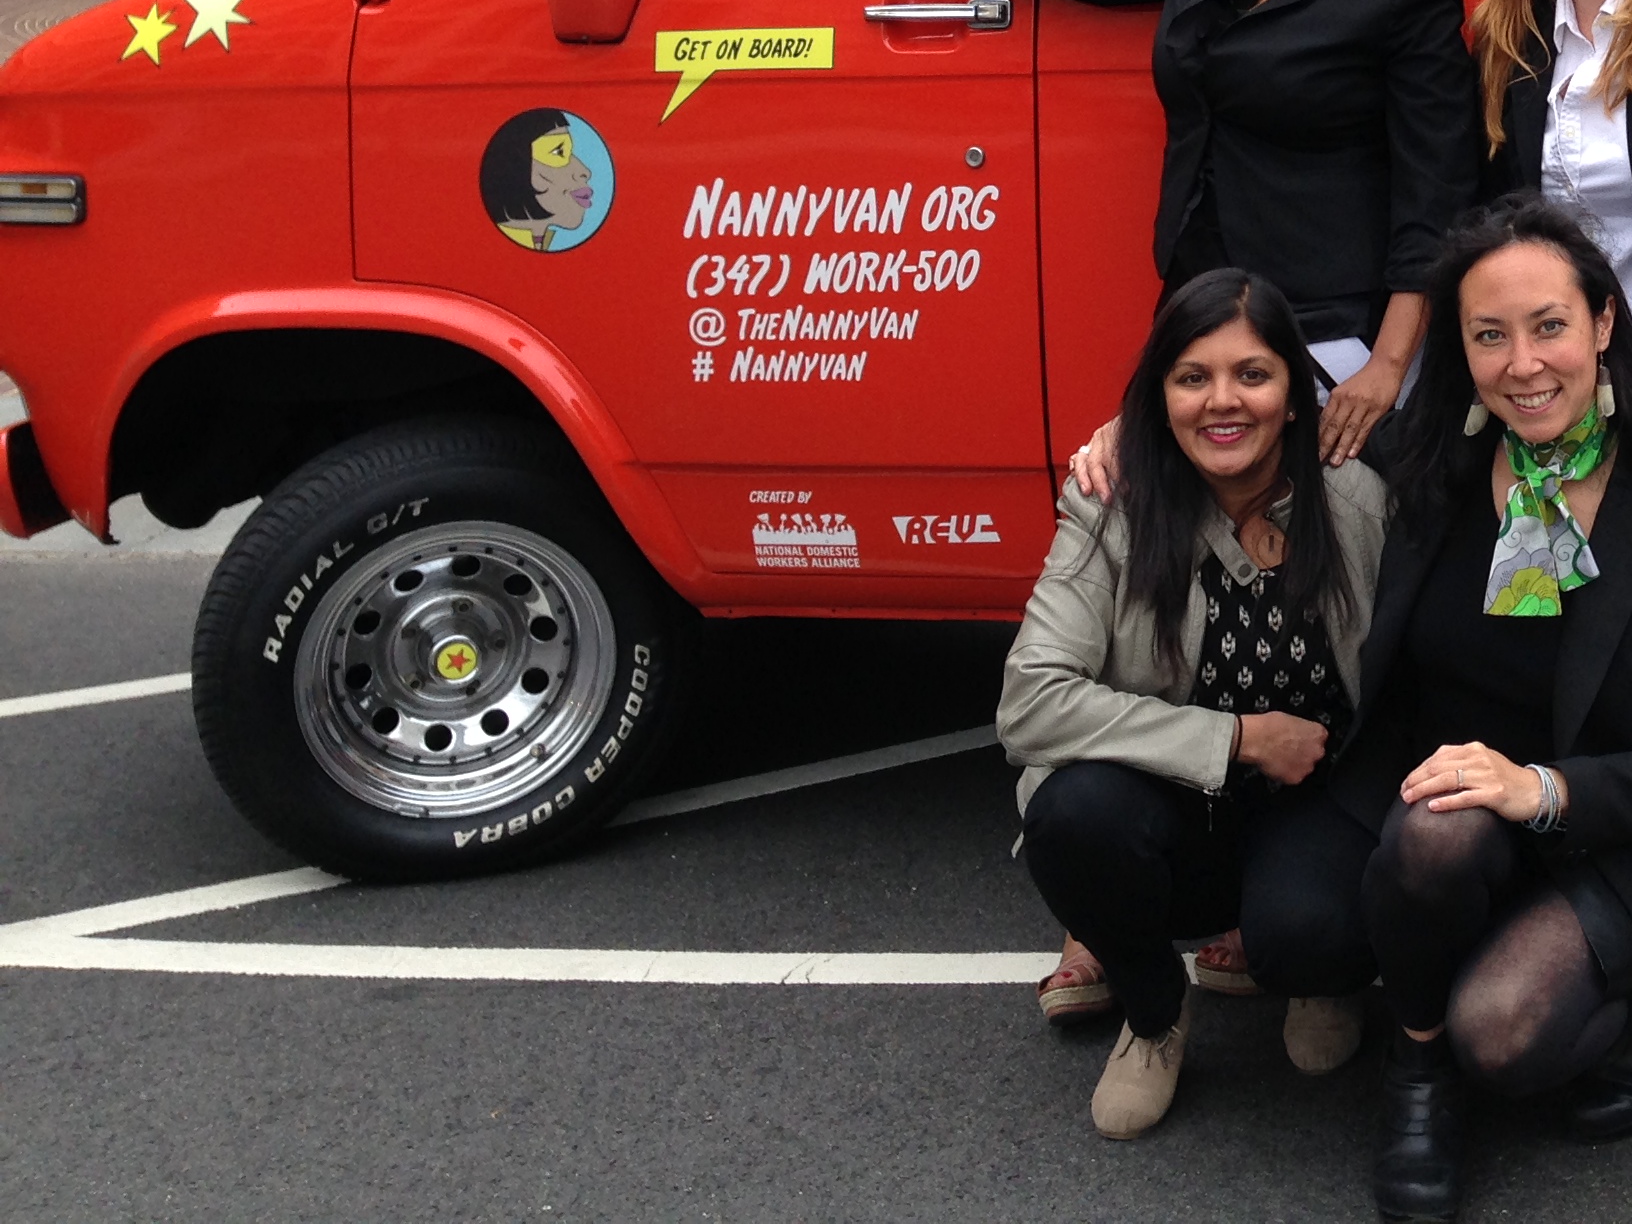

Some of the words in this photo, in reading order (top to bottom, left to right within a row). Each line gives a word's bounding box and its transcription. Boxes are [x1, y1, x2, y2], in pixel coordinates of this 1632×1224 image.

[674, 37, 712, 61] GET
[716, 37, 743, 60] ON
[748, 37, 813, 58] BOARD!
[683, 177, 912, 239] NANNYVAN
[921, 185, 999, 232] ORG
[686, 254, 790, 298] (347)
[803, 249, 980, 294] WORK-500
[738, 304, 919, 341] THENANNYVAN
[730, 346, 867, 382] NANNYVAN
[749, 490, 794, 503] CREATED
[797, 490, 812, 504] BY
[755, 546, 804, 556] NATIONAL
[807, 546, 859, 557] DOMESTIC
[757, 557, 808, 567] WORKERS
[811, 558, 861, 568] ALLIANCE
[263, 537, 356, 664] RADIAL
[367, 497, 430, 535] G/T
[584, 644, 652, 784] COOPER
[454, 785, 577, 850] COBRA
